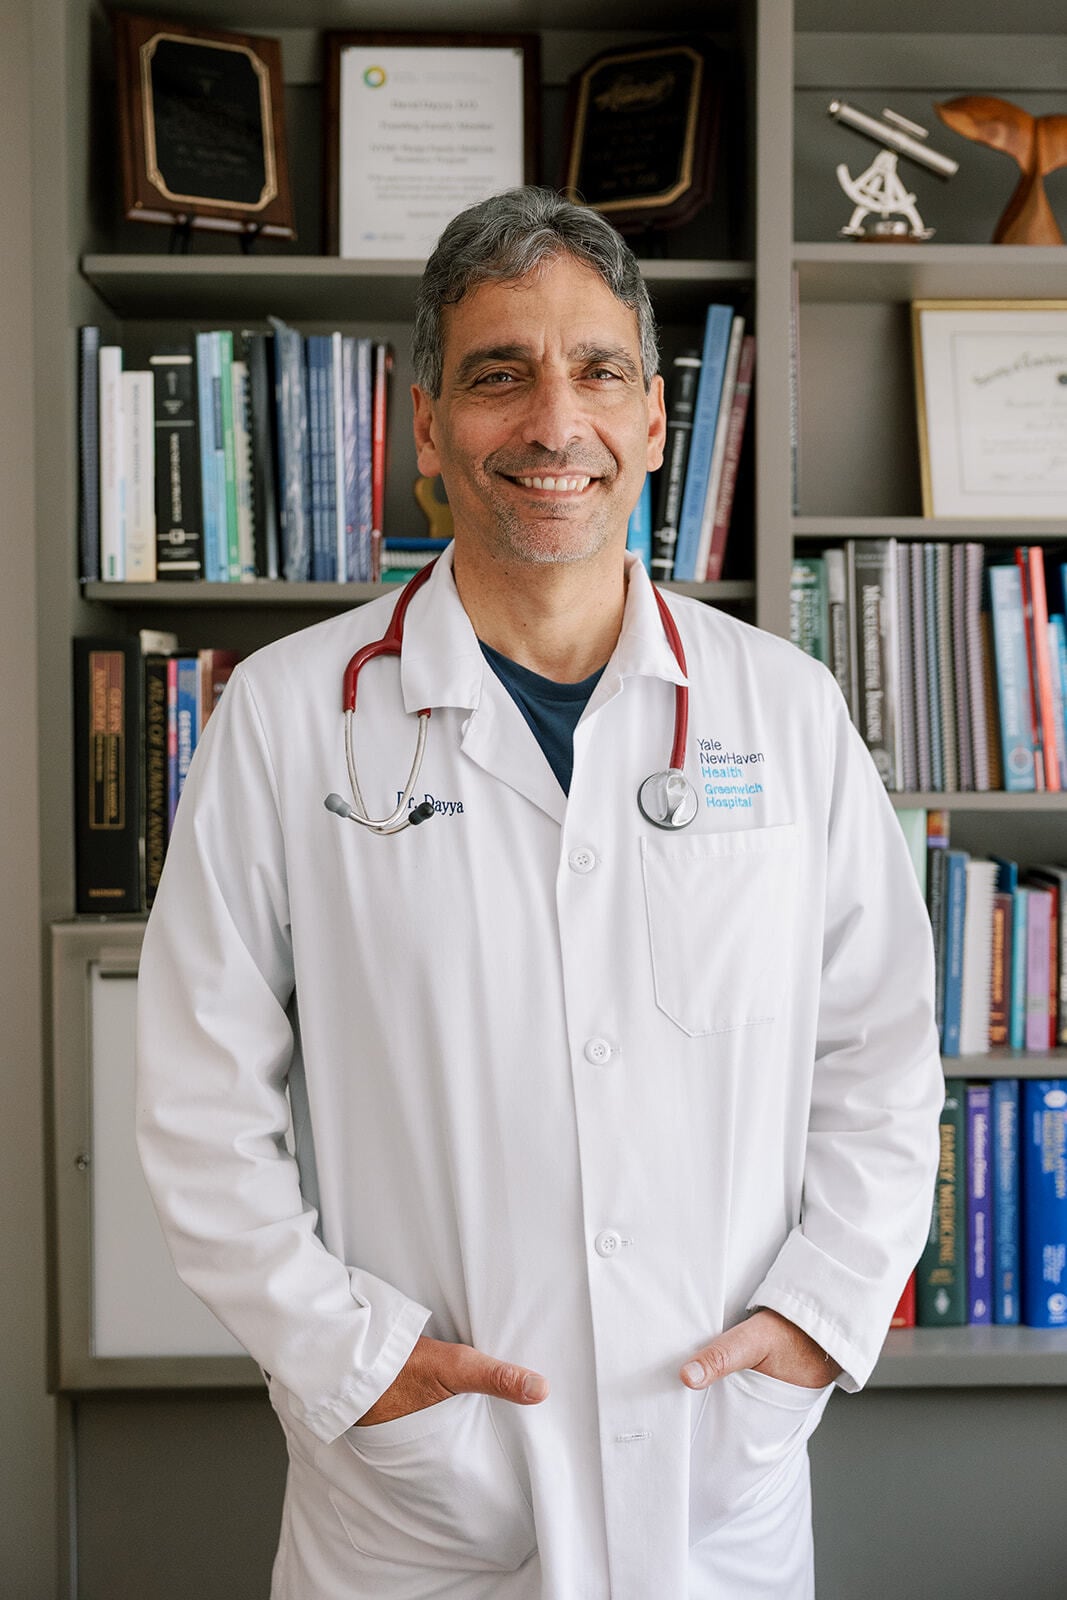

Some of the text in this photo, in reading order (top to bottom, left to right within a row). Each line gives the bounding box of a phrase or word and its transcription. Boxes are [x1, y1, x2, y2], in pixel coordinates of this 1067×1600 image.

[697, 738, 722, 750] Yale
[699, 752, 765, 764] NewHaven
[701, 766, 743, 778] Health
[704, 783, 764, 795] Greenwich
[424, 793, 464, 816] Dayya
[706, 796, 753, 809] Hospital
